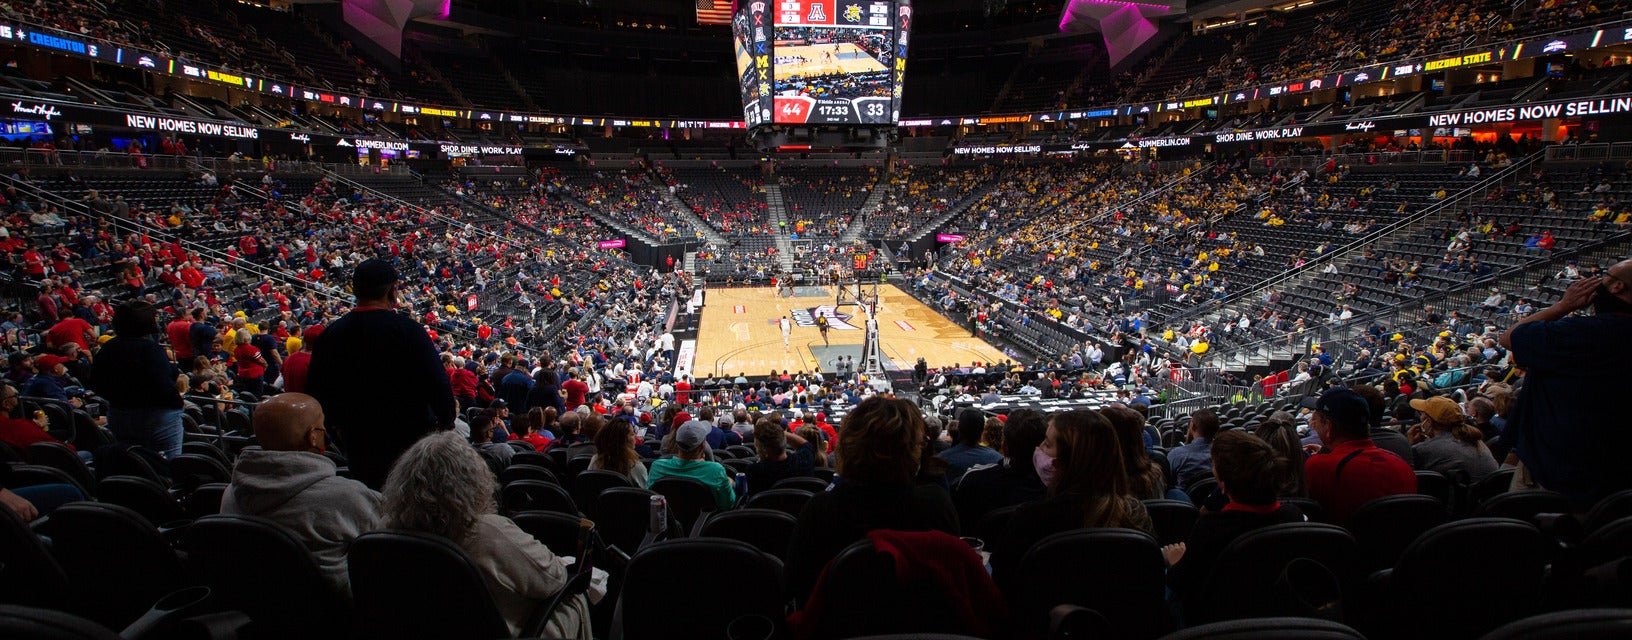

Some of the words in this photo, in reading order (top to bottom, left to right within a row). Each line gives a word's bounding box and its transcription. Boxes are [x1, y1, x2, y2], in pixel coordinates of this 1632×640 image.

[808, 3, 826, 21] A
[29, 32, 85, 54] CREIGHTON
[756, 55, 769, 68] M
[895, 58, 905, 71] M
[1424, 57, 1462, 71] ARIZONA
[1463, 52, 1492, 65] STATE
[782, 103, 801, 116] 44
[819, 106, 849, 115] 17:33
[867, 103, 884, 116] 33
[1429, 112, 1461, 127] NEW
[1464, 109, 1515, 124] HOMES
[1520, 104, 1561, 120] NOW
[1565, 98, 1632, 116] SELLIN
[127, 114, 155, 129] NEW
[158, 117, 196, 133] HOMES
[198, 122, 222, 136] NOW
[223, 125, 258, 139] SELLING
[1216, 133, 1235, 143] SHOP.
[1236, 131, 1254, 141] DINE.
[1255, 129, 1280, 140] WORK.
[1282, 127, 1303, 138] PLAY
[355, 138, 409, 151] SUMMERLIN.COM
[440, 144, 460, 153] SHOP.
[461, 146, 480, 154] DINE.
[481, 147, 505, 155] WORK.
[1013, 145, 1041, 153] SELLING
[1138, 137, 1190, 149] SUMMERLIN.COM
